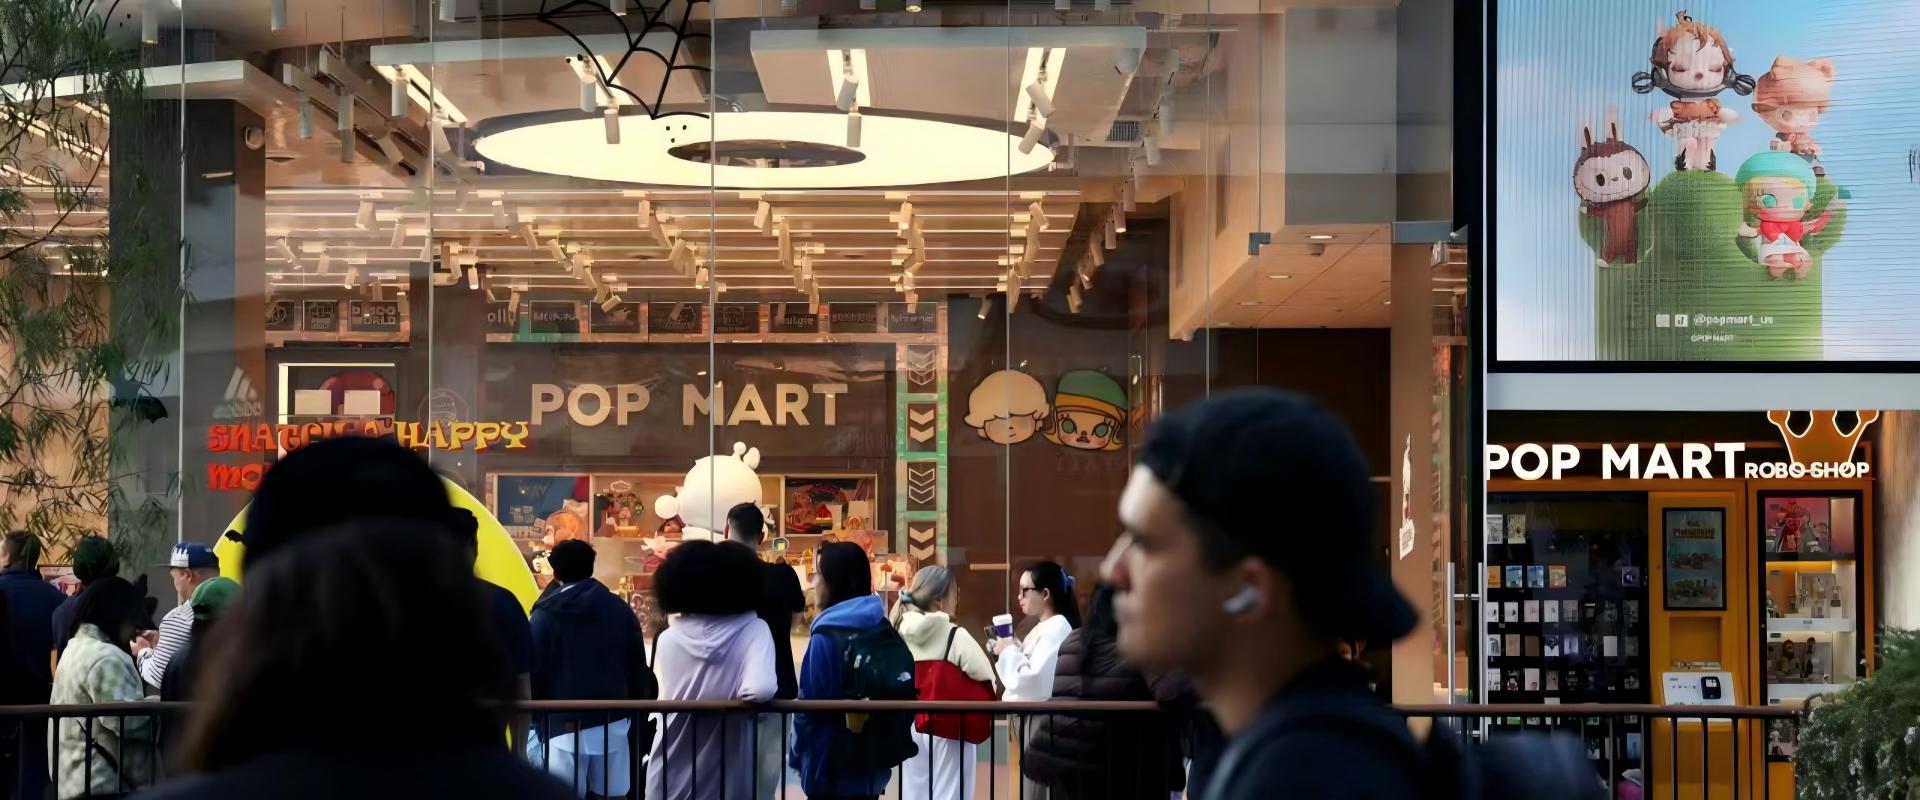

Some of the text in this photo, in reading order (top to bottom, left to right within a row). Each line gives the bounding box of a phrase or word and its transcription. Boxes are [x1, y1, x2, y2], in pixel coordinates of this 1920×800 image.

[531, 383, 849, 426] POP MART
[393, 421, 529, 451] HAPPY
[1486, 442, 1870, 480] POP MART ROBO SHOP
